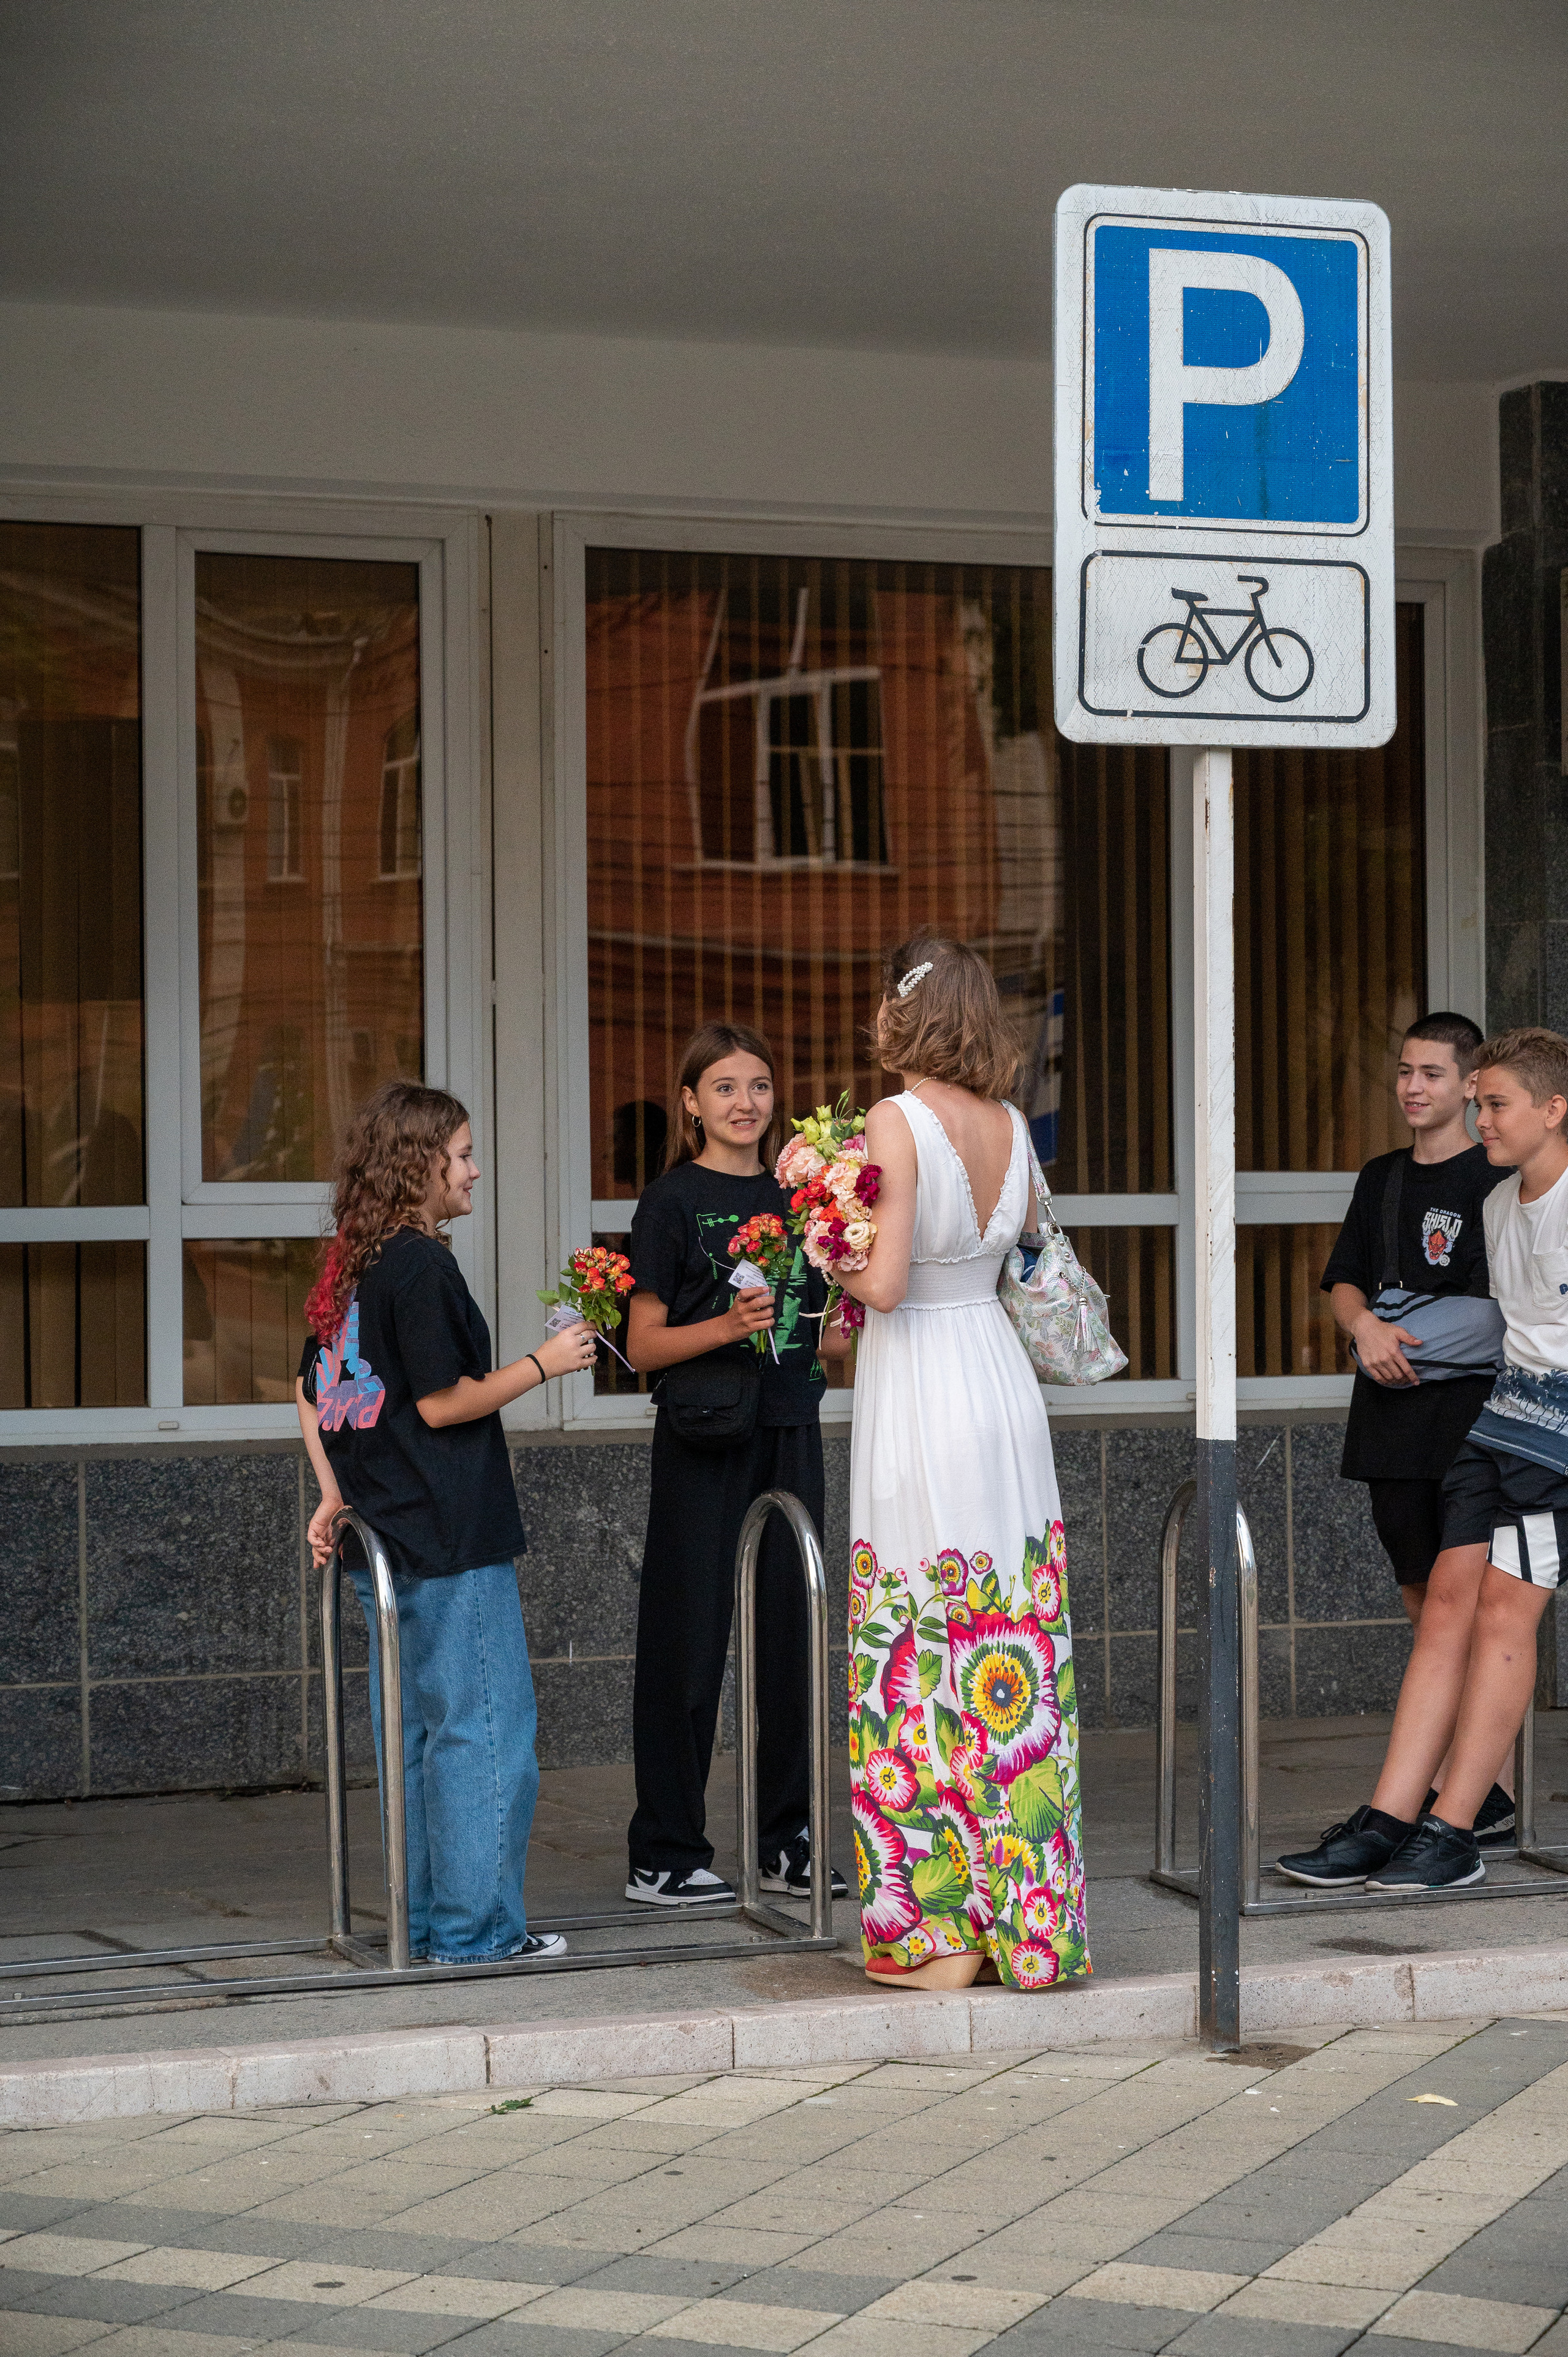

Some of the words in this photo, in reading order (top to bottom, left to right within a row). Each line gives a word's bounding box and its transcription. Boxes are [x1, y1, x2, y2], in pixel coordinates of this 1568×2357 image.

[1149, 248, 1305, 501] P
[1422, 1211, 1463, 1238] SHIELD
[1439, 1209, 1461, 1219] DRAGON
